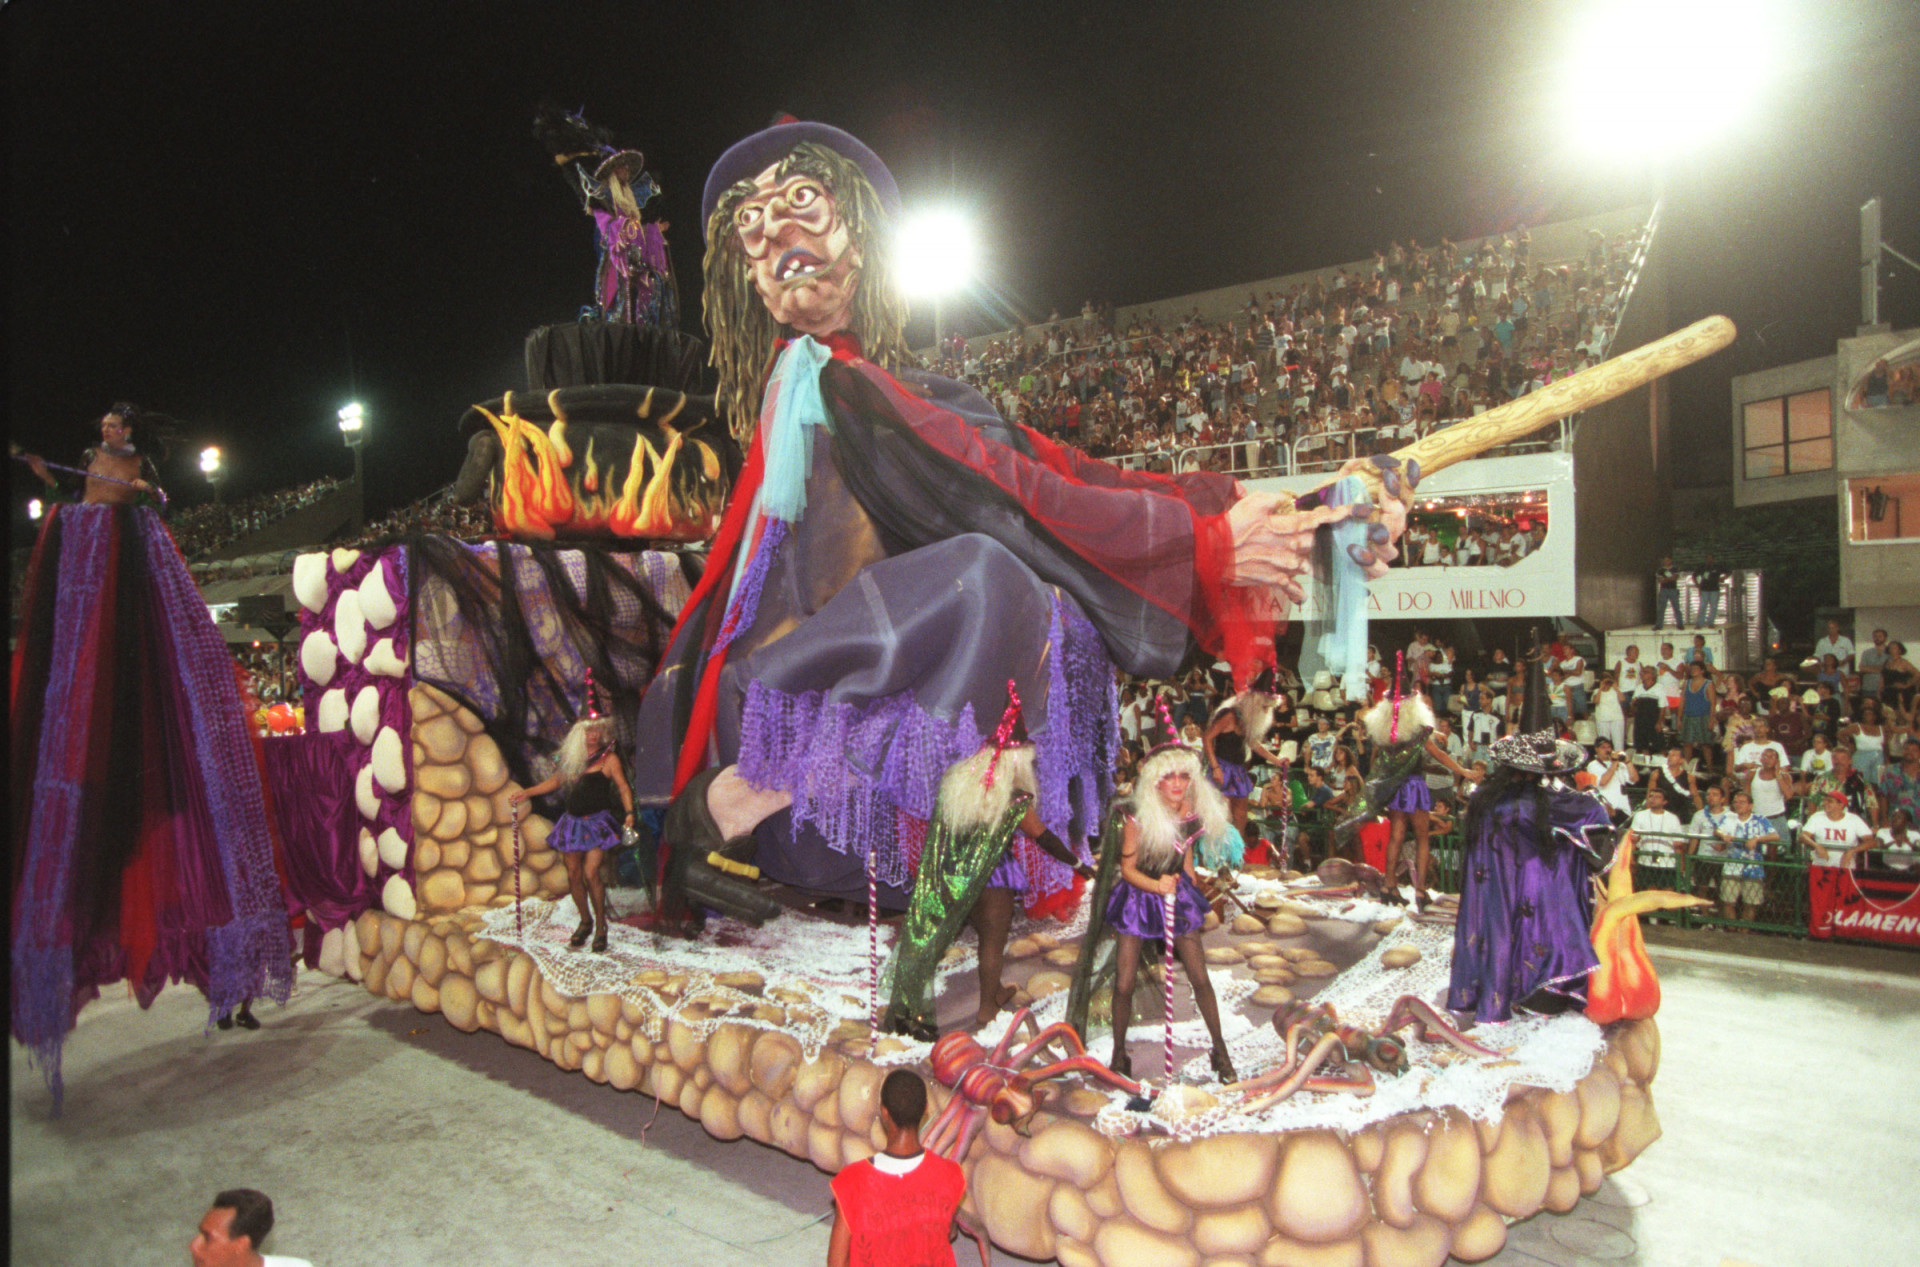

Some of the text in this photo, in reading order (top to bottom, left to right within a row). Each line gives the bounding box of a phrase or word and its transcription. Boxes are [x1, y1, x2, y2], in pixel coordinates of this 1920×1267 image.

[1398, 591, 1432, 611] DO
[1448, 588, 1526, 610] MILENIO
[1824, 827, 1847, 842] IN
[1834, 909, 1920, 934] LAMEN
